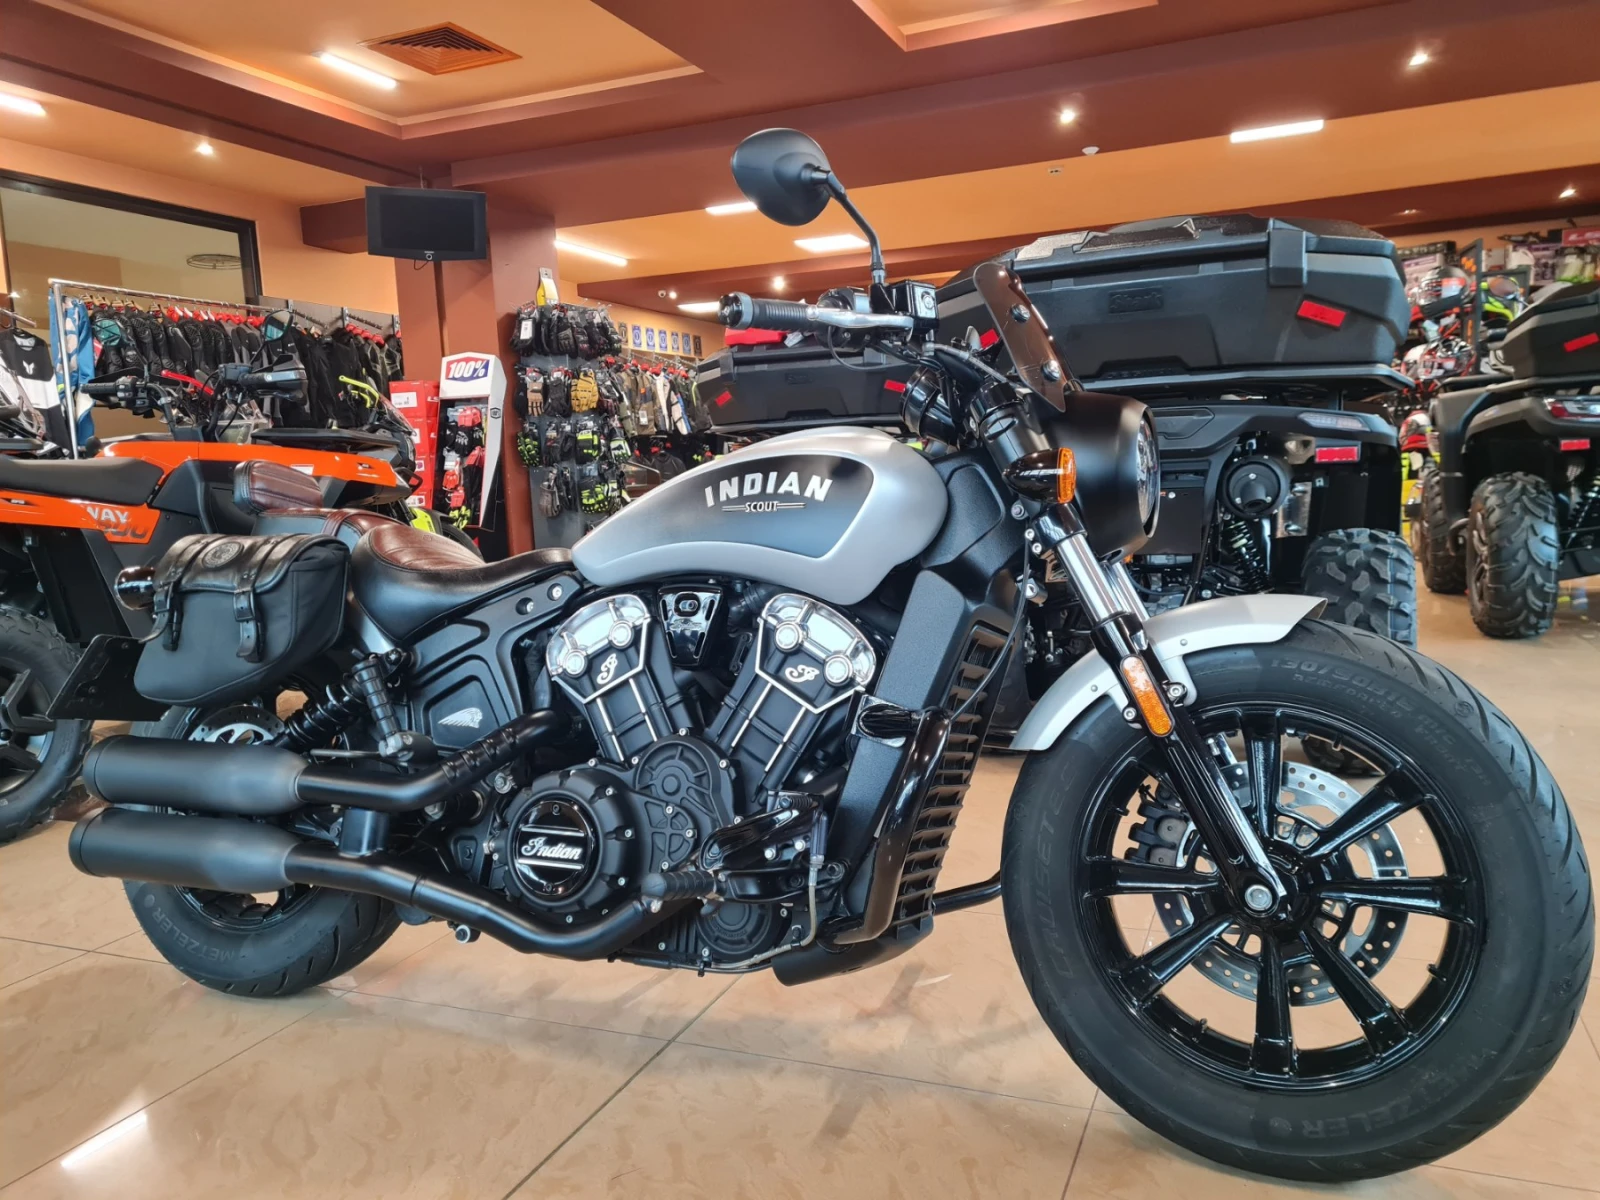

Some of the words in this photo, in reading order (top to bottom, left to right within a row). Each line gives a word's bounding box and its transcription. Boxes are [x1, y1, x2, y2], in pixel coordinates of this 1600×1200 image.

[447, 360, 487, 379] 100%
[705, 471, 833, 508] INDIAN
[745, 500, 779, 512] SCOUT
[521, 836, 583, 860] Indian
[152, 907, 234, 962] METZELER
